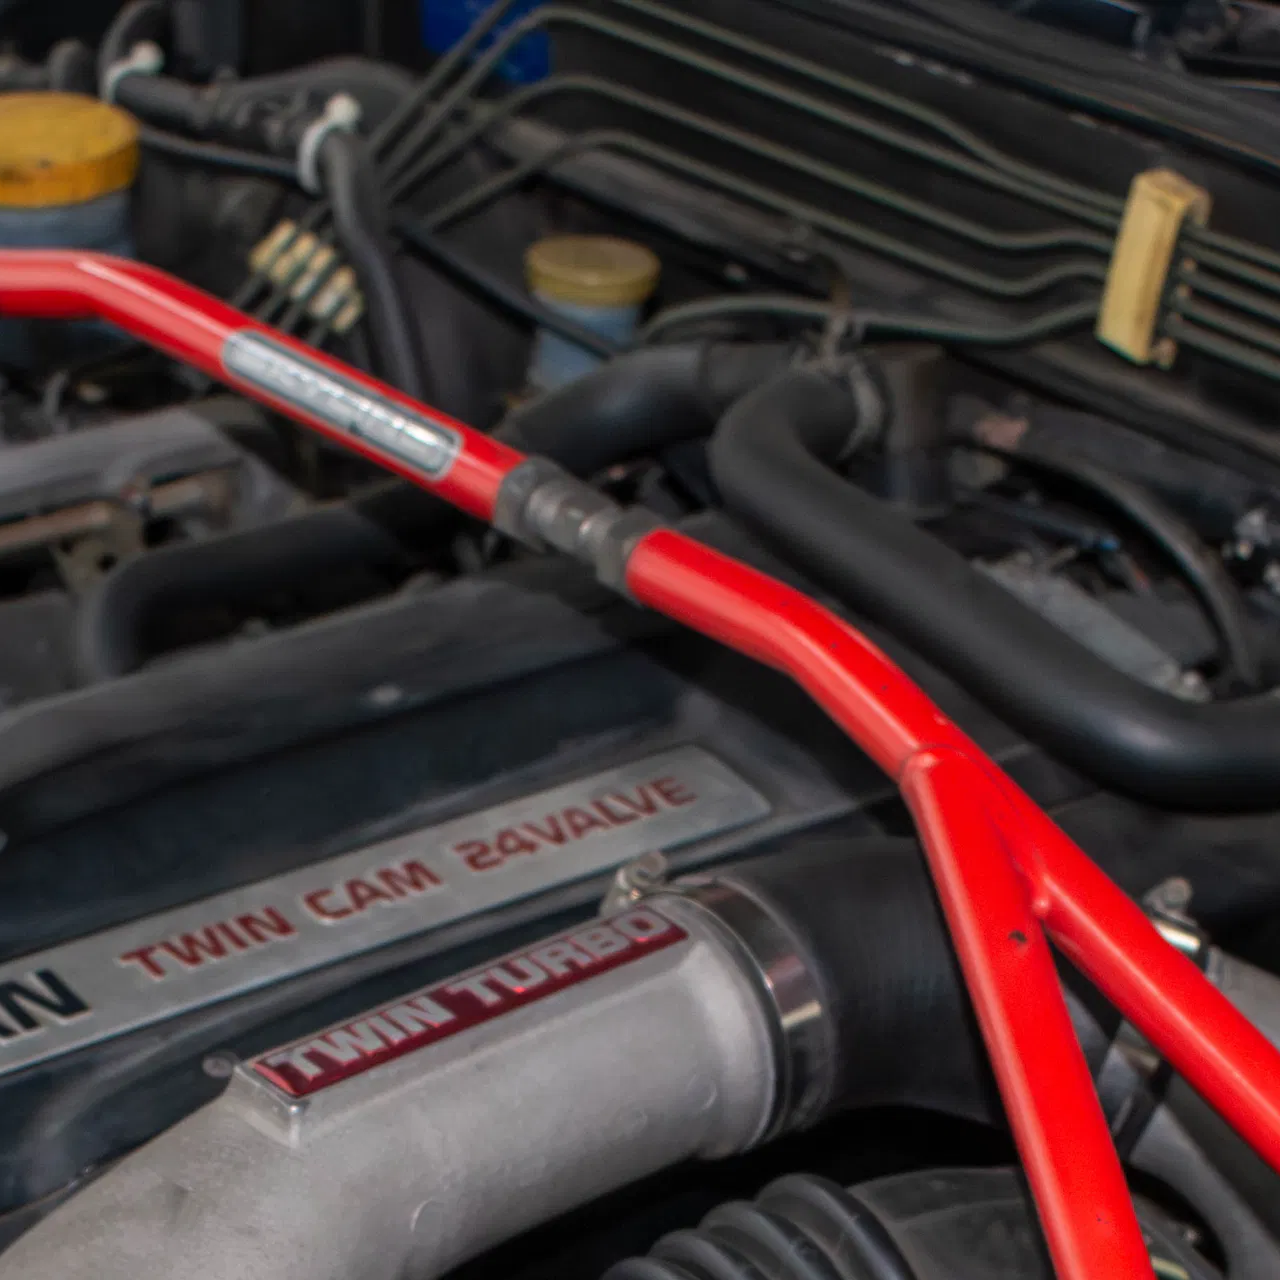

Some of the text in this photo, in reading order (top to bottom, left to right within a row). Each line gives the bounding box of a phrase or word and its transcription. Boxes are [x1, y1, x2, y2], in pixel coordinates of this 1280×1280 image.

[120, 904, 299, 980] TWIN
[305, 858, 443, 924] CAM
[452, 775, 699, 873] 24VALVE
[266, 907, 674, 1080] TWIN TURBO
